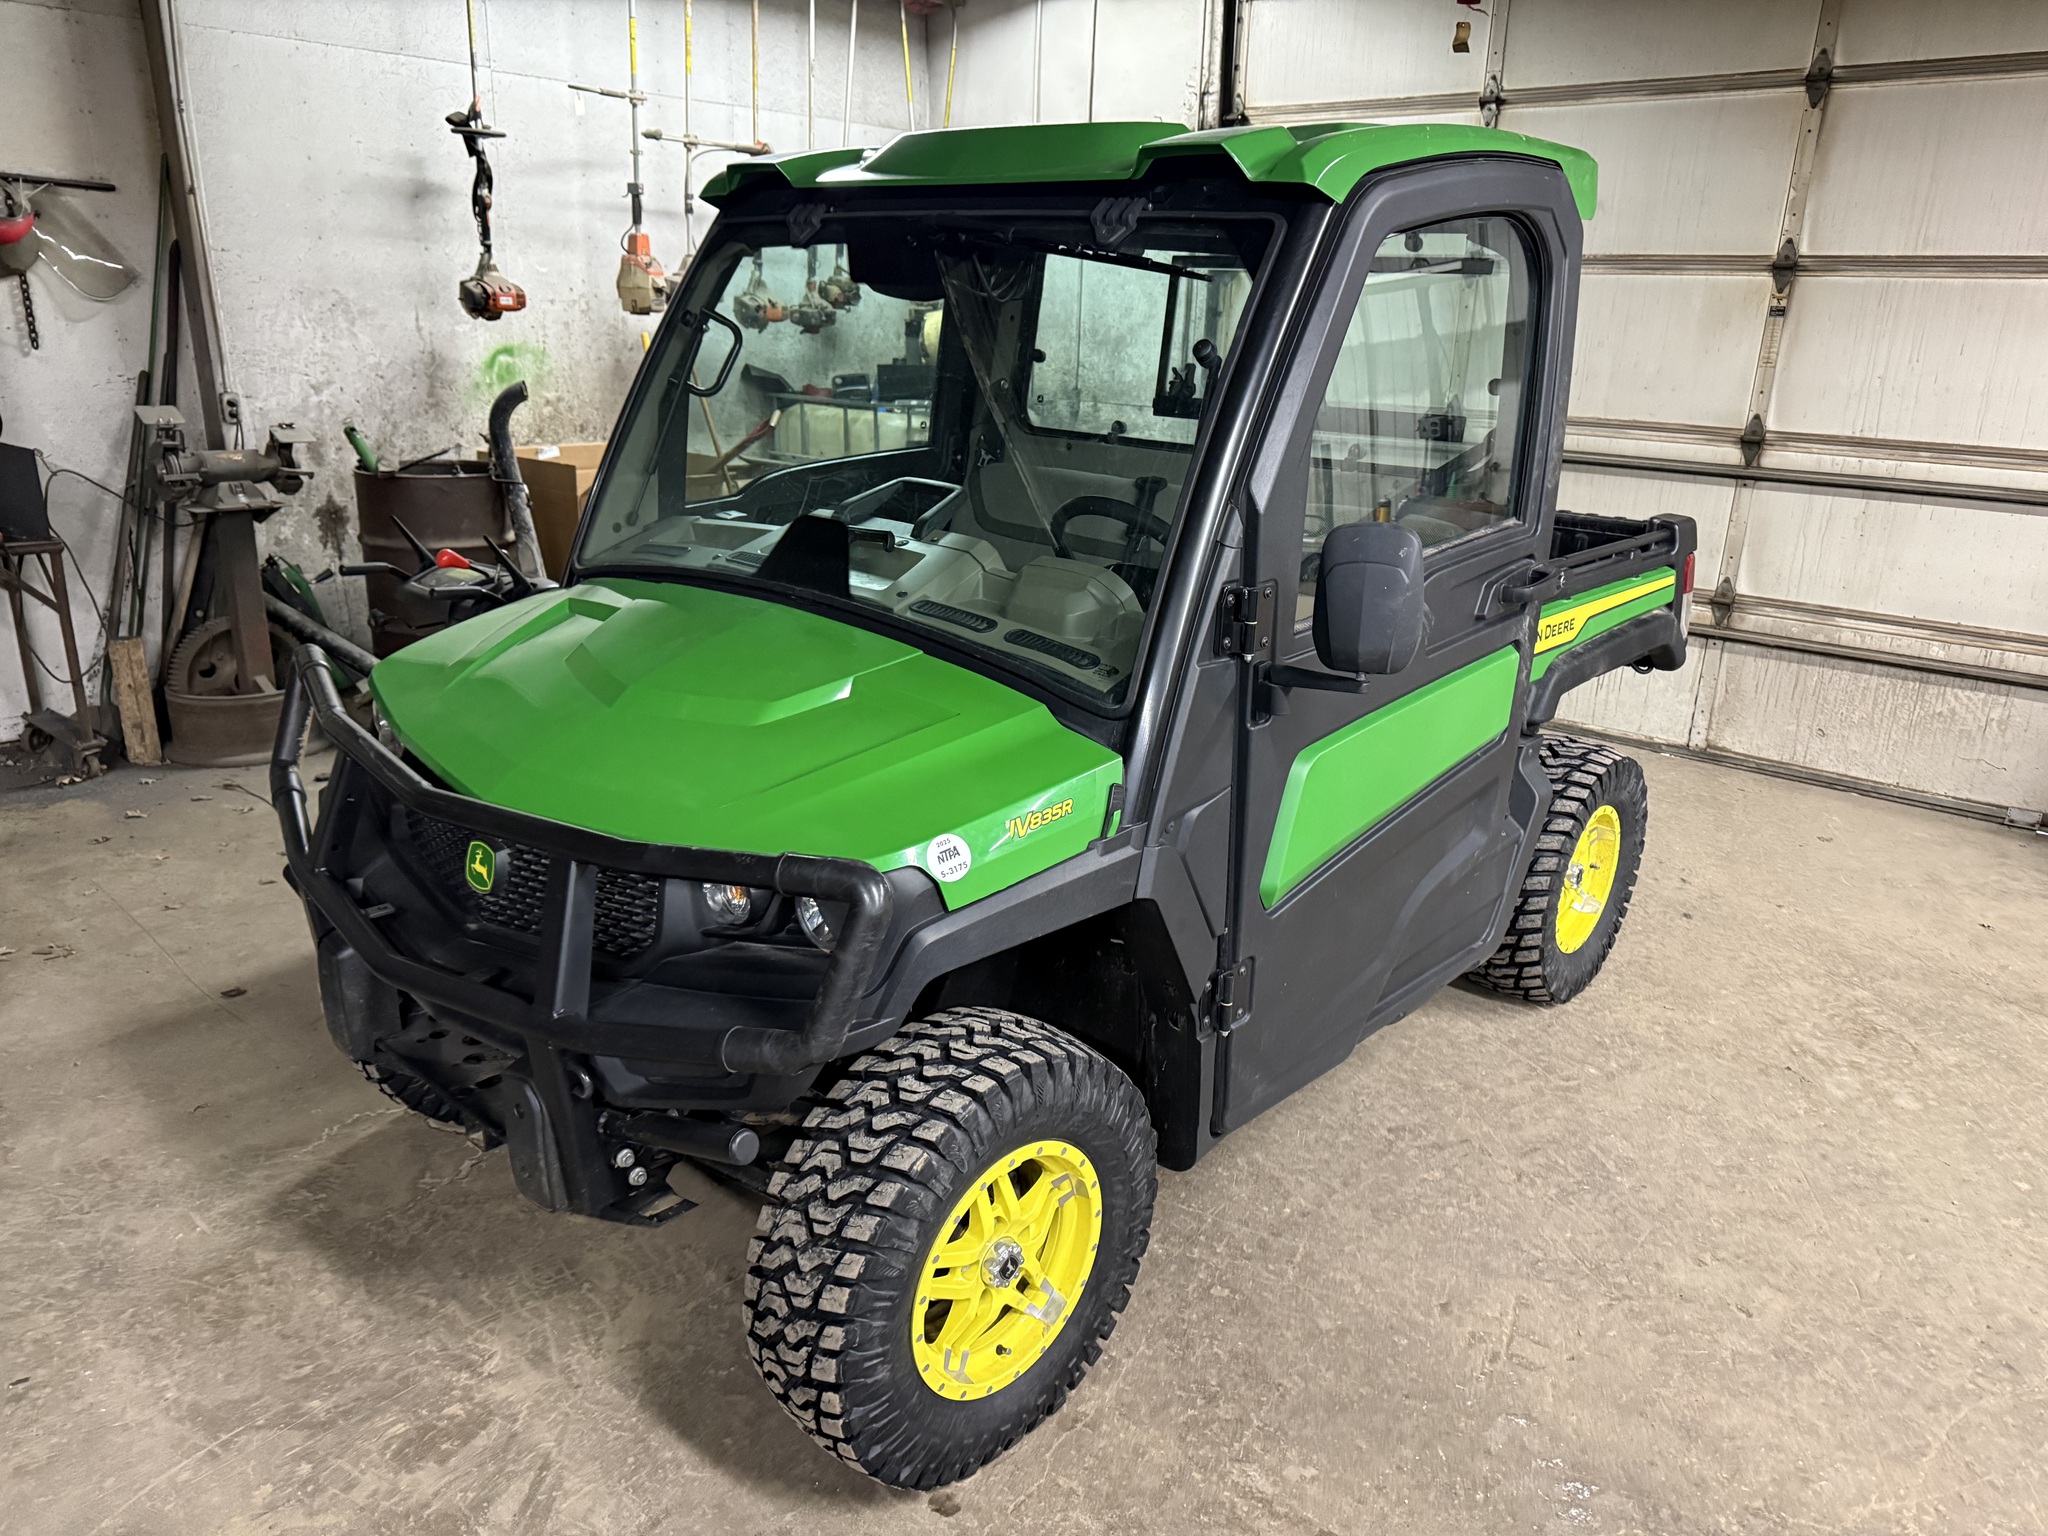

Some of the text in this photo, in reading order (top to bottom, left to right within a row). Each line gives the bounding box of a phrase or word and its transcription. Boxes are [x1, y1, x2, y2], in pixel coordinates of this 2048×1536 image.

[1545, 617, 1576, 640] DEERE
[936, 838, 951, 848] 2025
[937, 845, 961, 865] NTPA
[940, 860, 968, 878] S-3175
